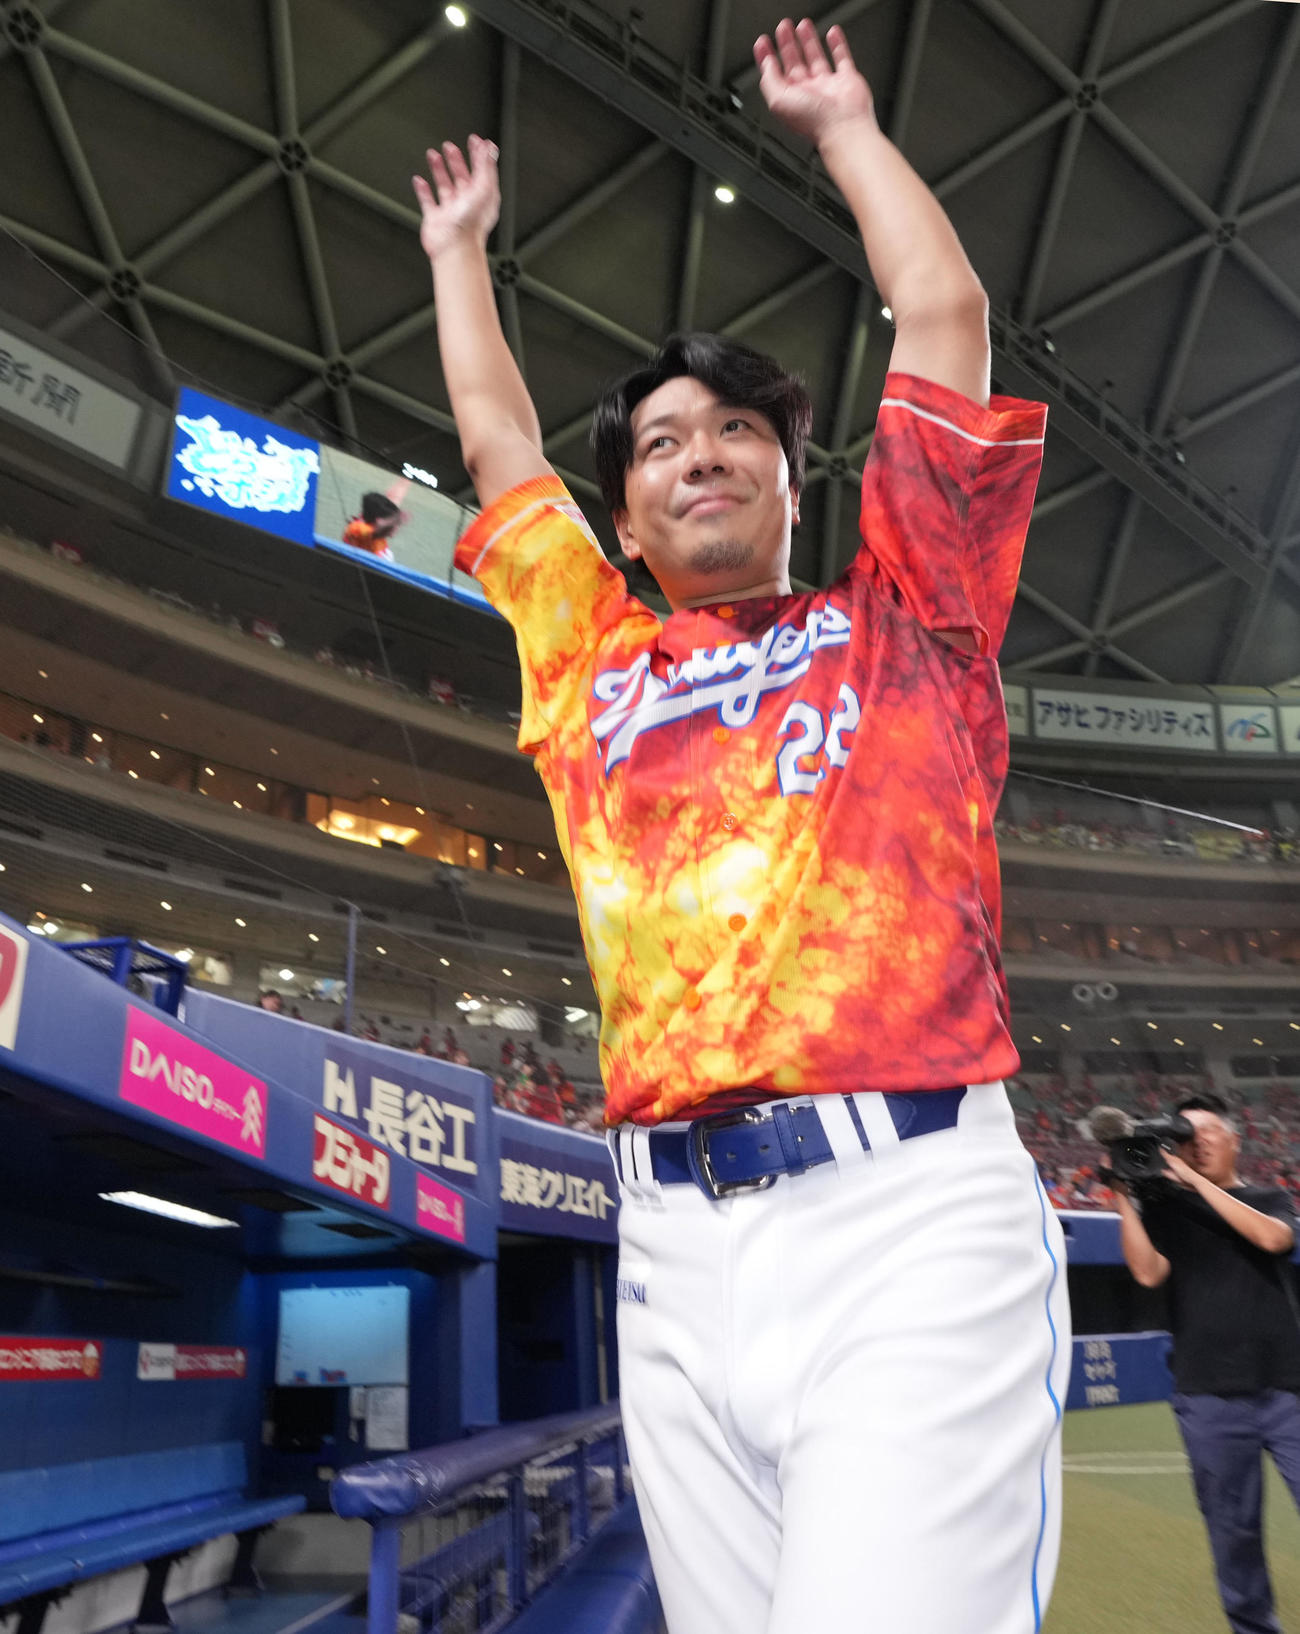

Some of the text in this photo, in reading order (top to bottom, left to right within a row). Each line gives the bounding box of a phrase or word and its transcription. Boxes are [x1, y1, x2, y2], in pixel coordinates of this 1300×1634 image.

[776, 682, 861, 797] 22
[129, 1037, 214, 1110] DAISO
[363, 1075, 478, 1176] 長谷工
